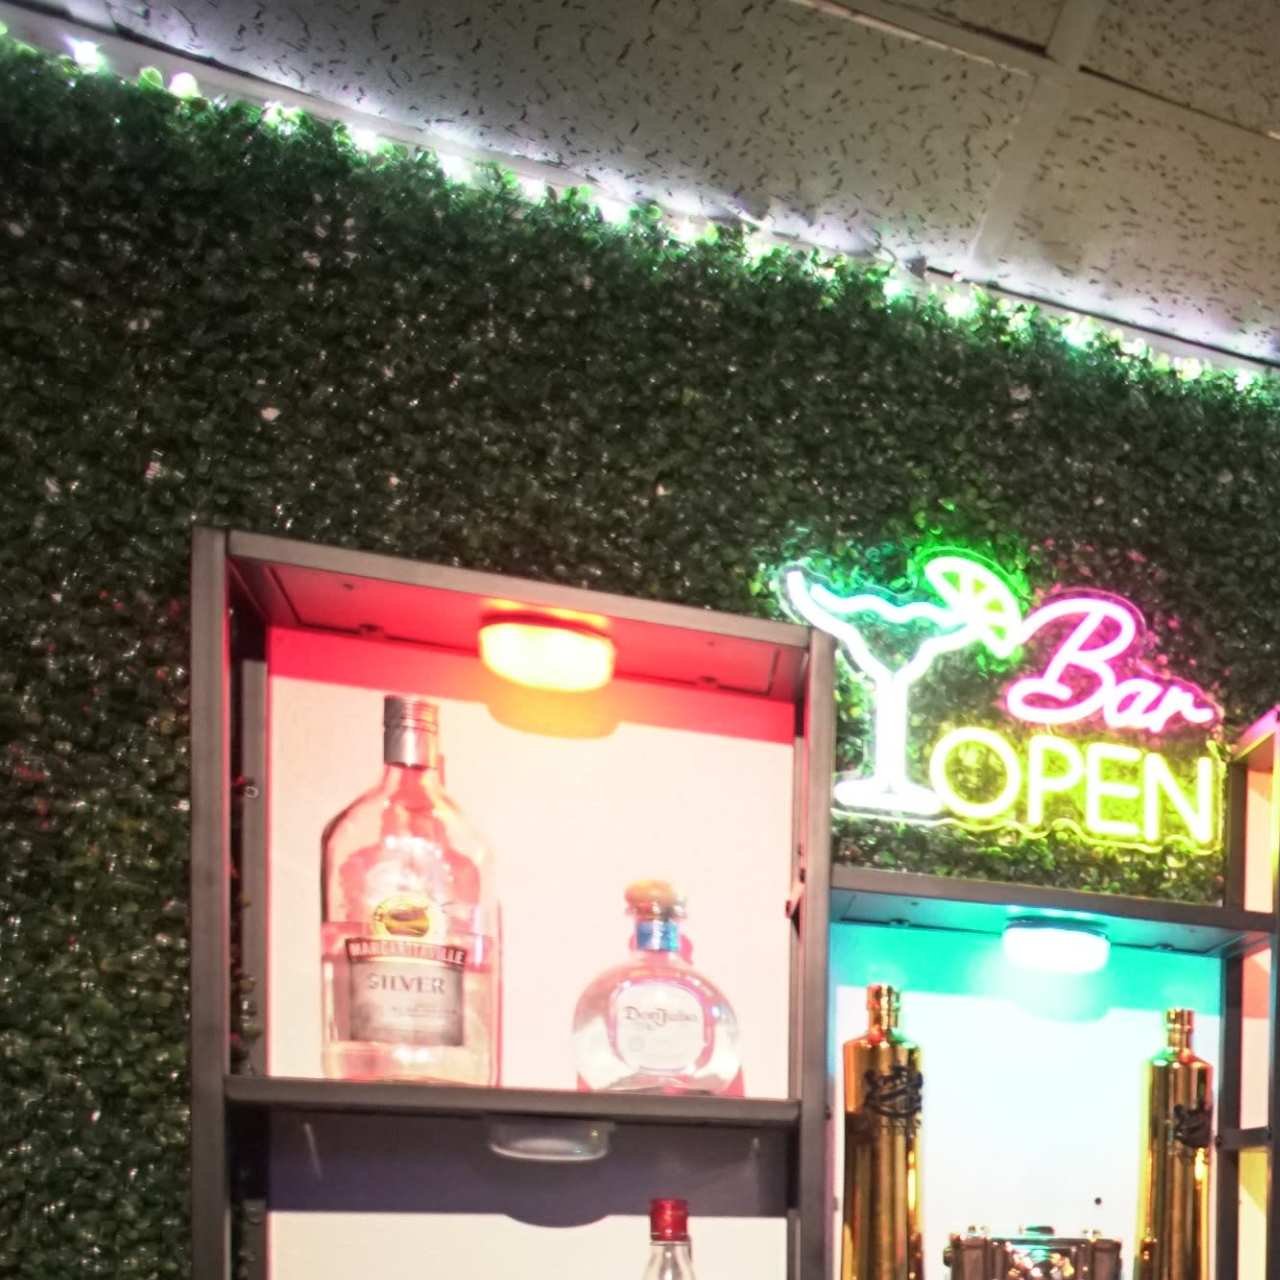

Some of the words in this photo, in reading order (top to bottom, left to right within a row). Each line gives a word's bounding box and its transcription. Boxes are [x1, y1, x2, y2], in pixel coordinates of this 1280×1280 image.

[1007, 596, 1214, 732] Bar
[930, 726, 1214, 843] OPEN
[368, 973, 445, 995] SILVER
